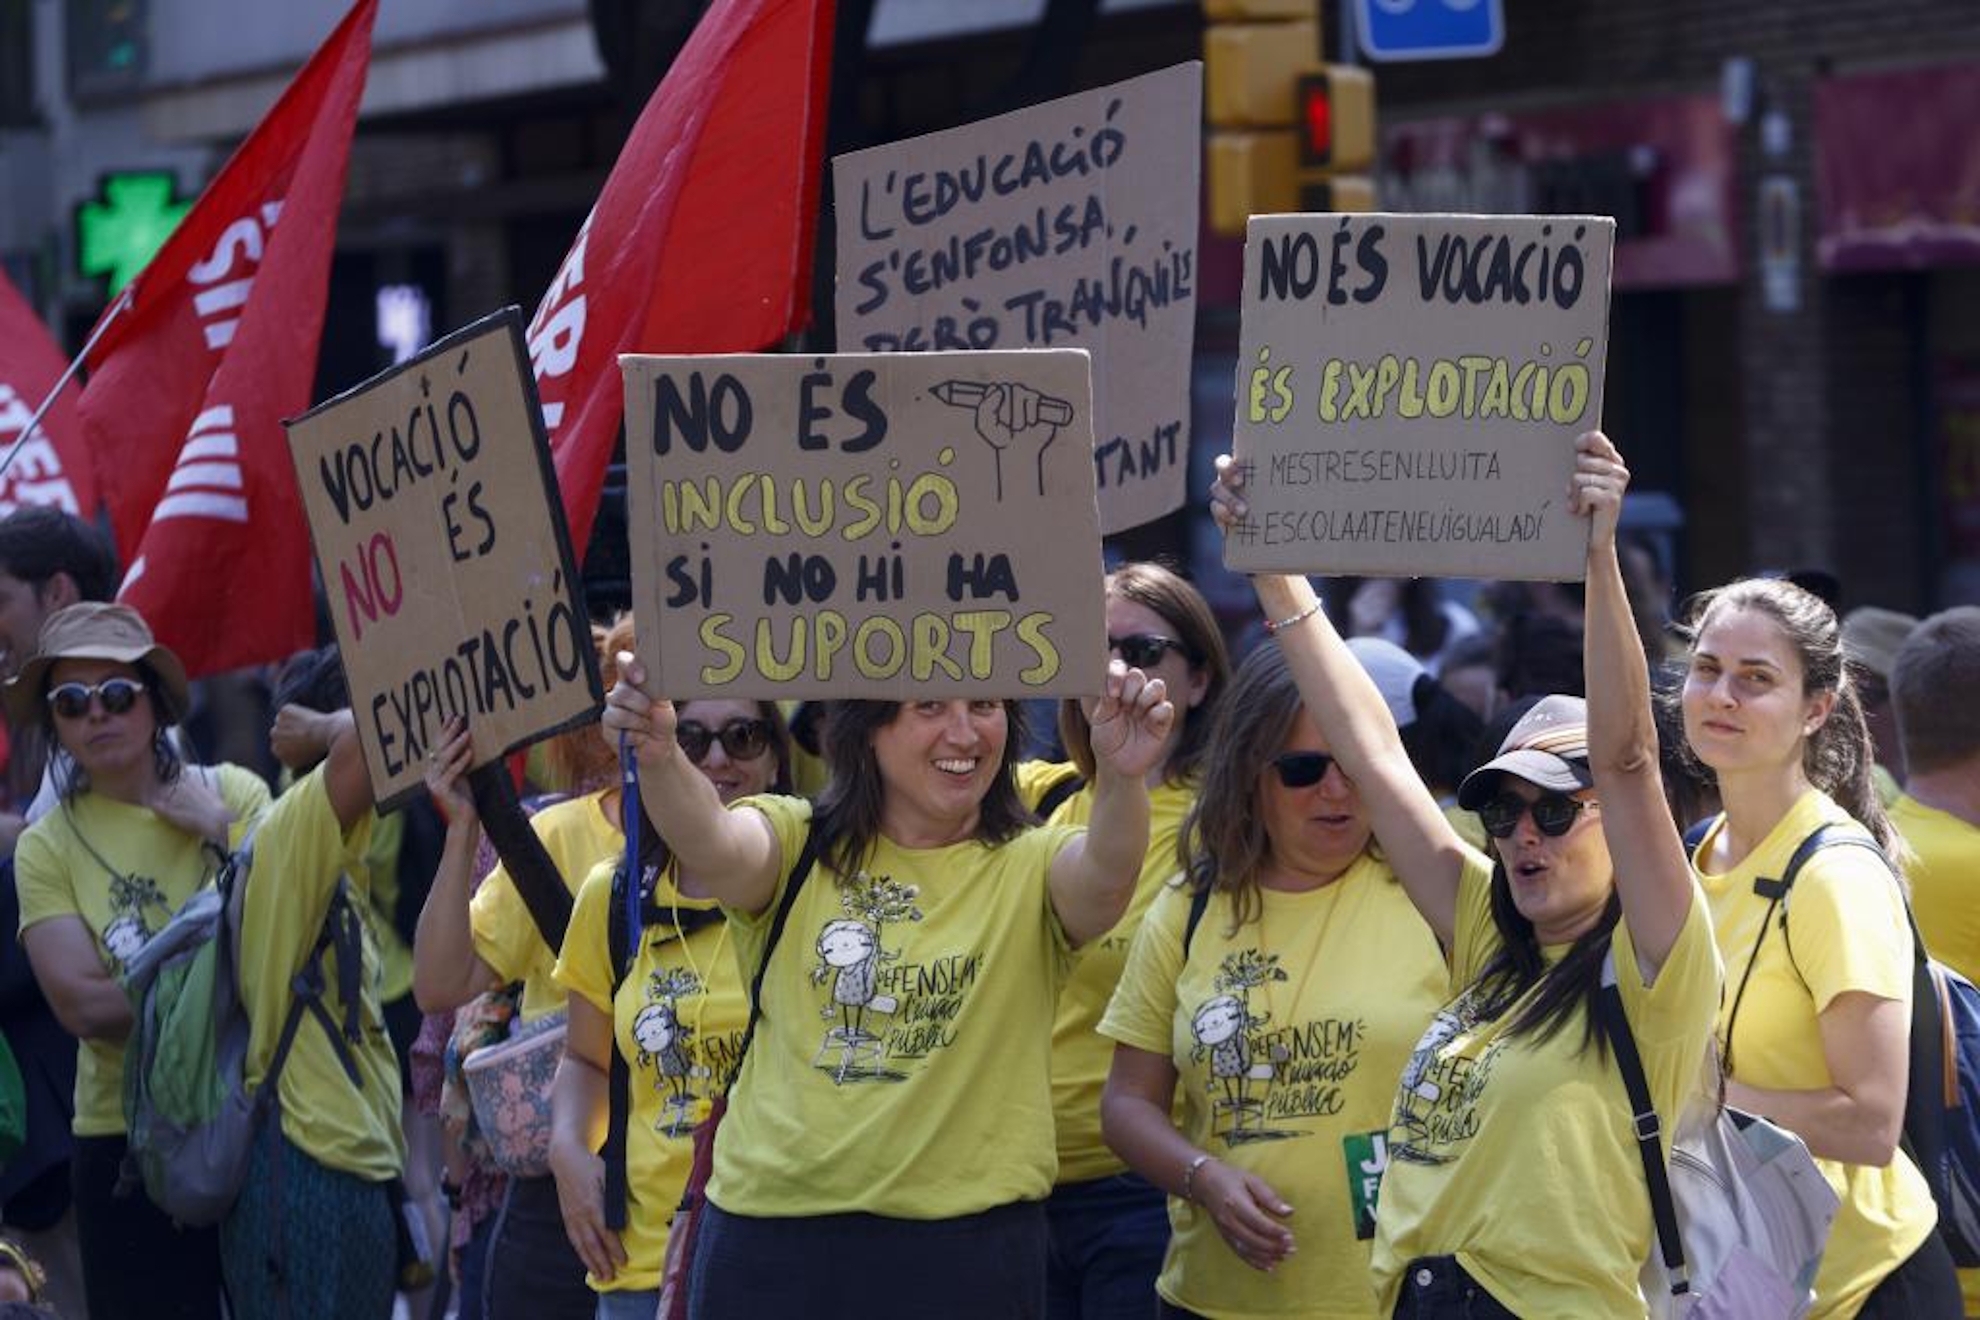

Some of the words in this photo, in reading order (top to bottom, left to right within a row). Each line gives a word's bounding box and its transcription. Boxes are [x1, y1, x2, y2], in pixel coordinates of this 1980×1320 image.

[861, 99, 1126, 241] L'EDUCACIÓ
[1259, 232, 1319, 301] NO
[1327, 216, 1388, 304] ÉS
[1417, 224, 1584, 309] VOCACIÓ
[653, 371, 753, 455] NO
[799, 357, 888, 453] ÉS
[1248, 346, 1293, 424] ÉS
[1318, 338, 1593, 425] EXPLOTACIÓ
[320, 351, 481, 525] VOCACIÓ
[442, 468, 496, 562] ÉS
[663, 446, 960, 541] INCLUSIÓ
[340, 528, 403, 641] NO
[665, 542, 712, 608] SI
[764, 553, 837, 603] NO
[856, 542, 903, 602] HI
[946, 552, 1020, 602] HA
[699, 610, 1061, 686] SUPORTS
